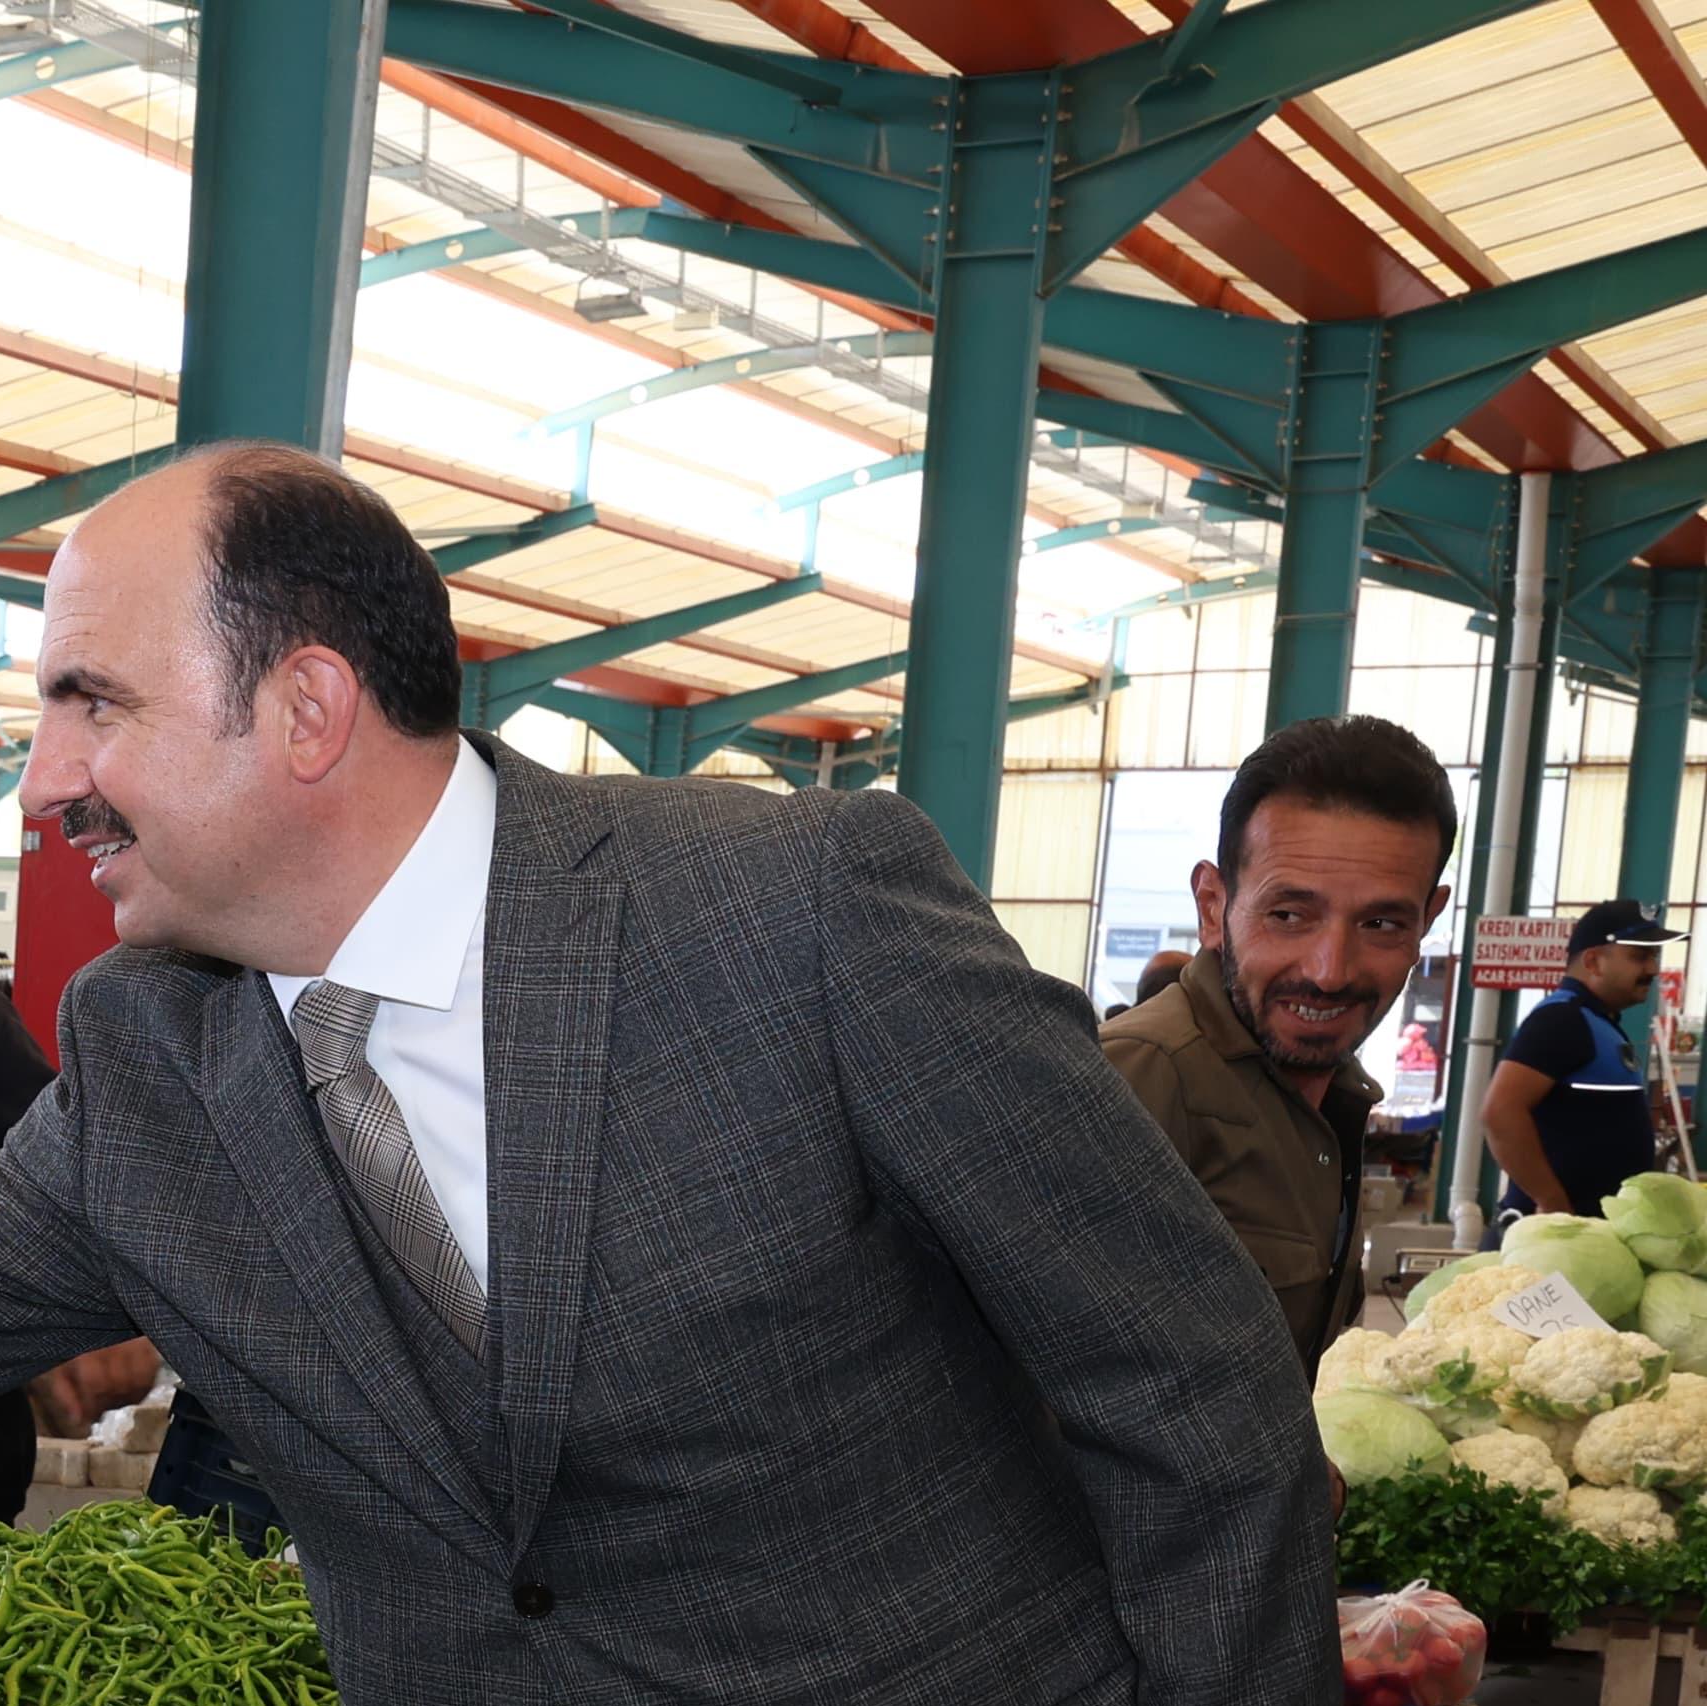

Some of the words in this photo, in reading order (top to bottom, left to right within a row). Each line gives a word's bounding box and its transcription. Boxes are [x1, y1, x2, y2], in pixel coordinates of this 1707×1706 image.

[1558, 919, 1576, 939] İL
[1474, 969, 1505, 983] ACAR
[1507, 1284, 1563, 1326] DANE
